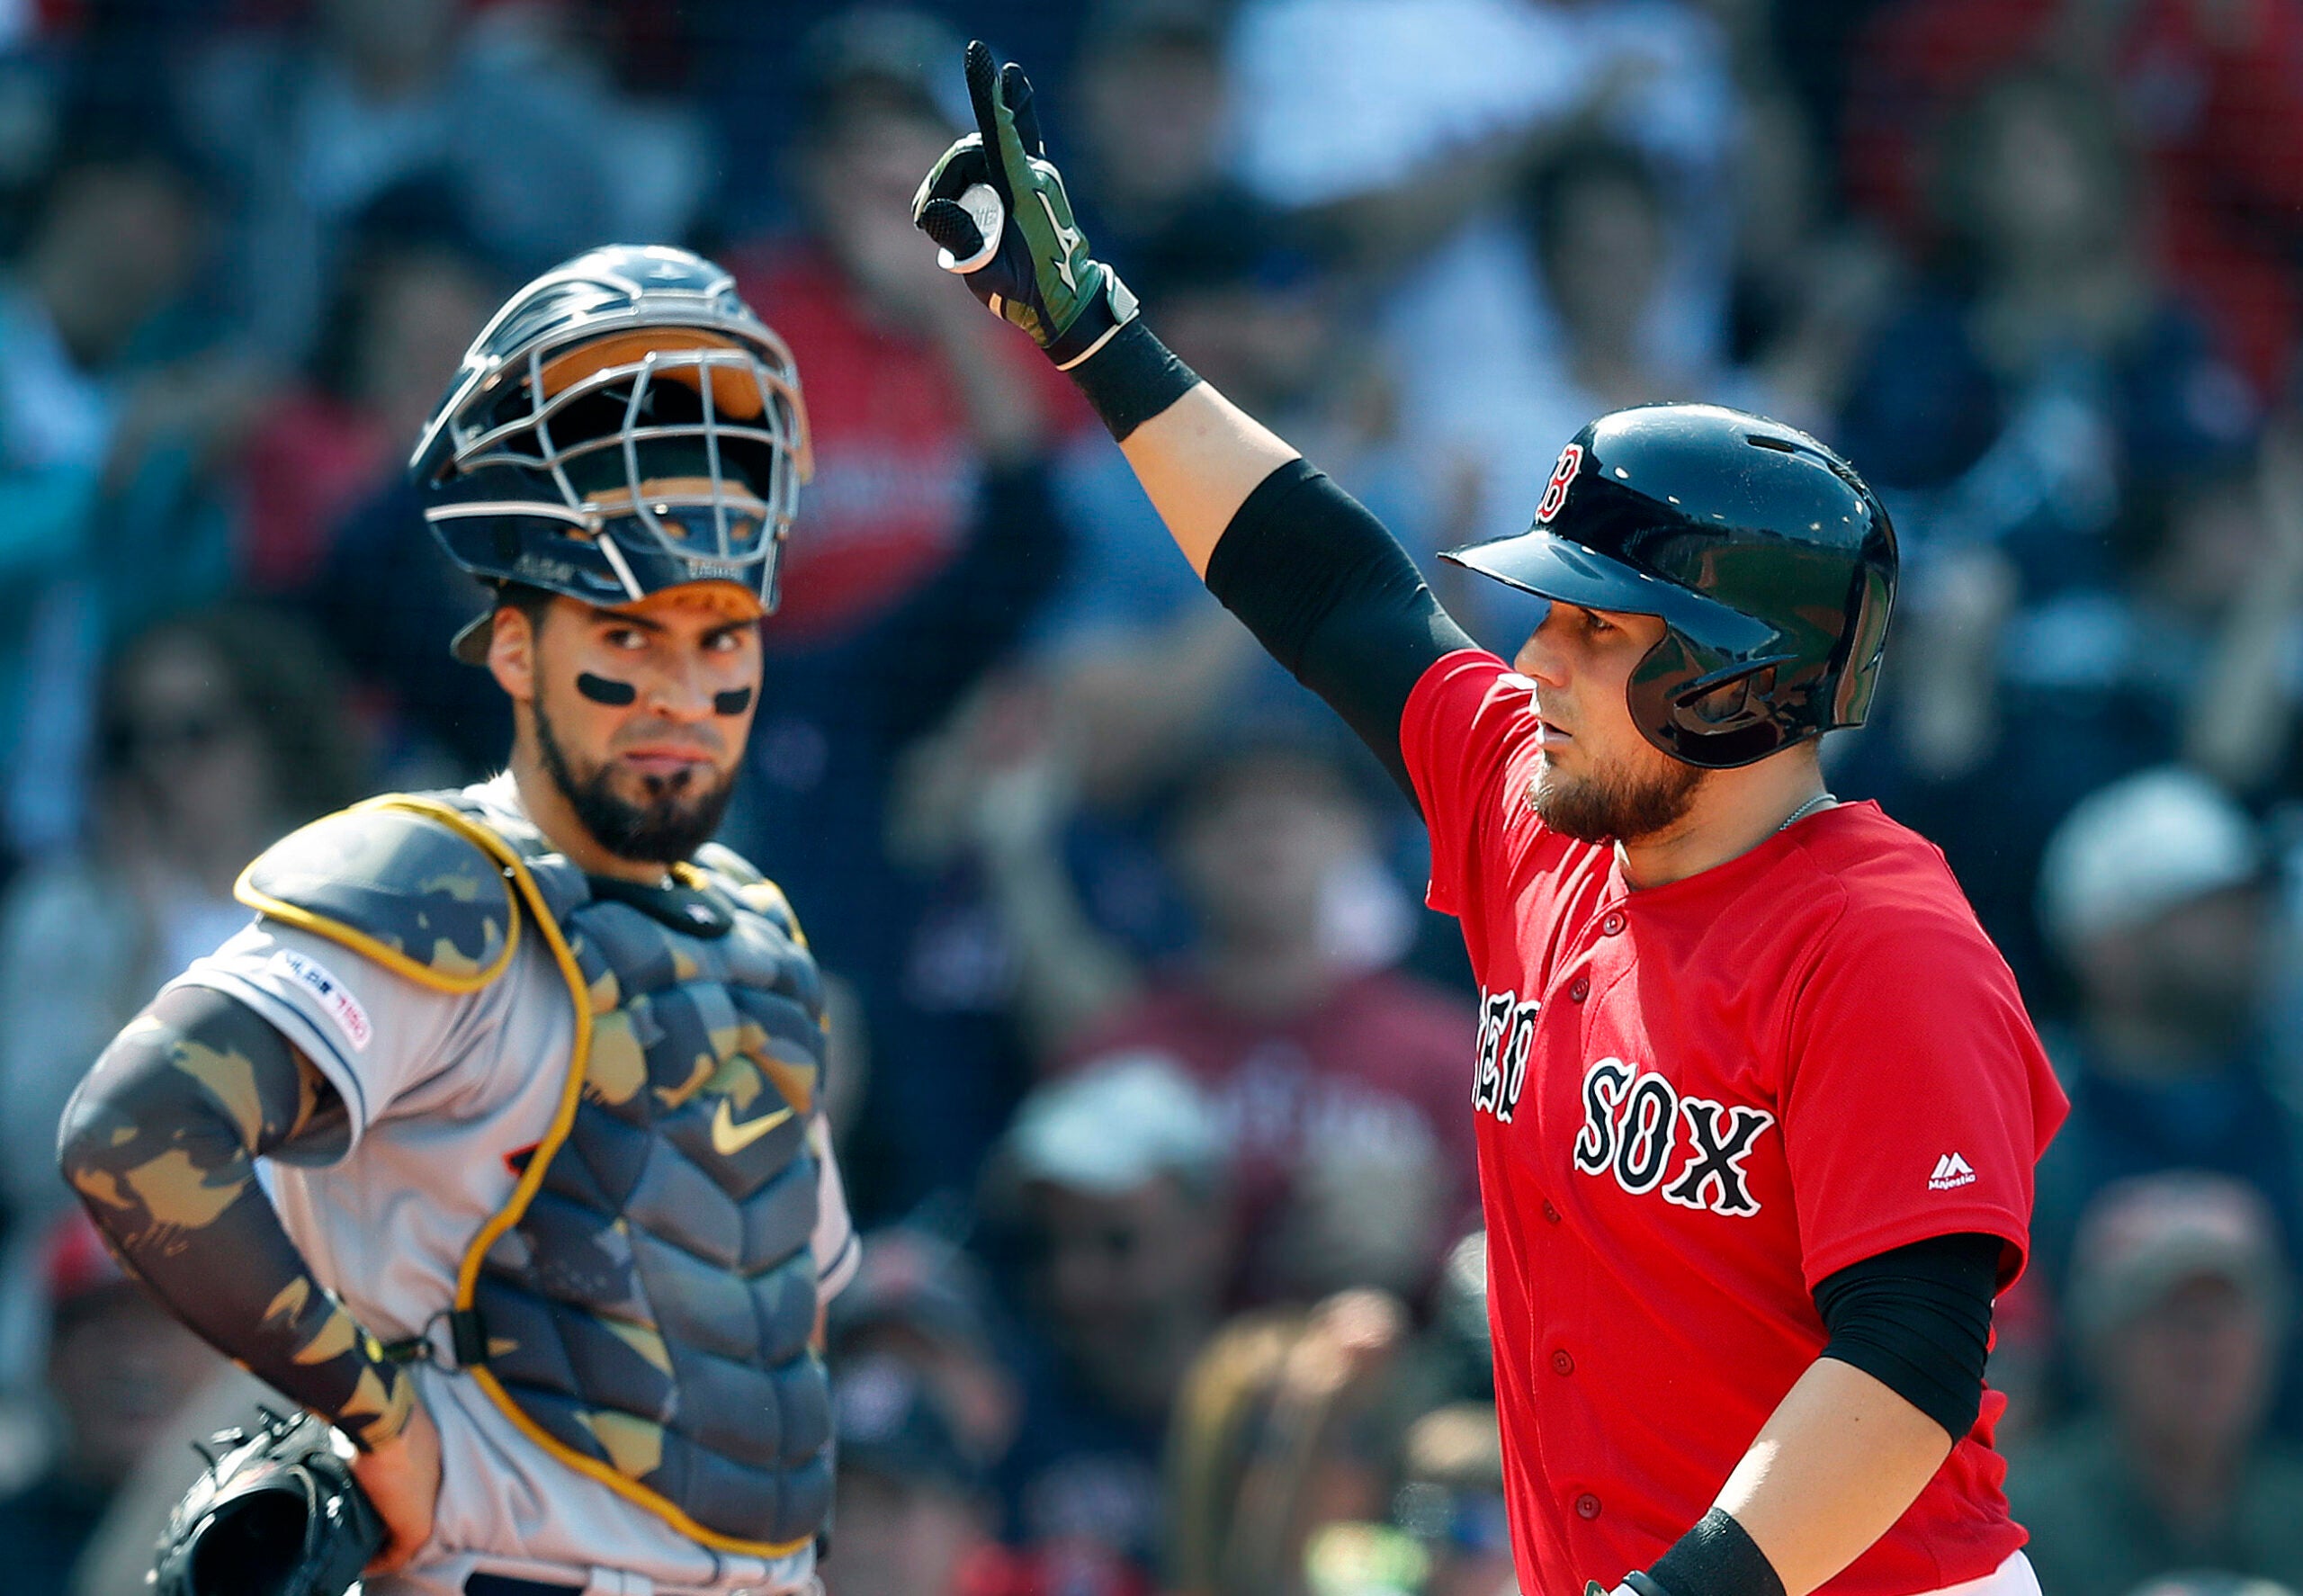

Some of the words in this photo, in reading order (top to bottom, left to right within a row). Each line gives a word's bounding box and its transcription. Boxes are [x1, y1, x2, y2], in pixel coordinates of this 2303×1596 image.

[1536, 444, 1583, 524] B
[1473, 985, 1540, 1124] ED
[1574, 1057, 1775, 1216] SOX
[1928, 1173, 1976, 1190] Majestic
